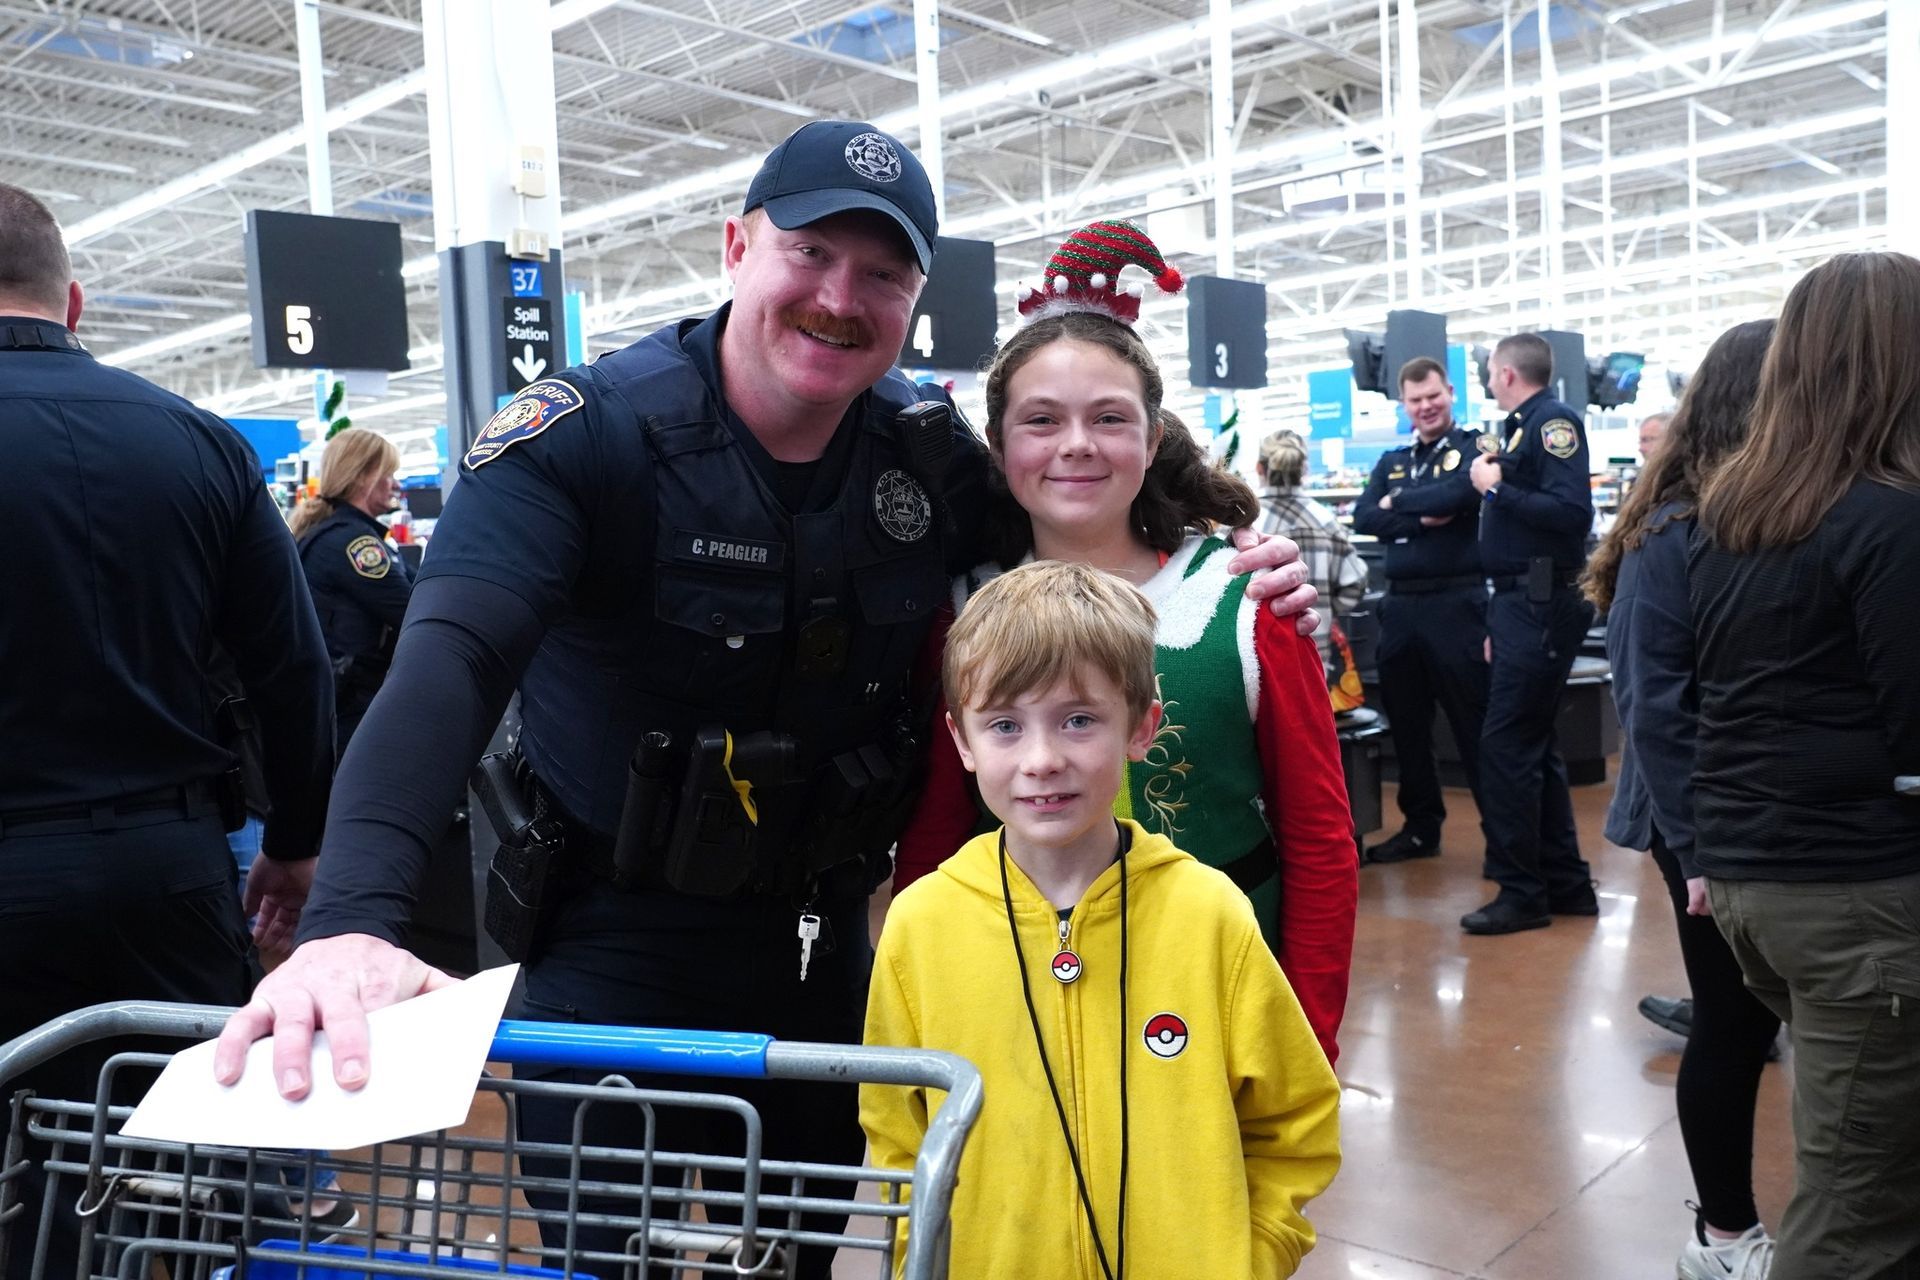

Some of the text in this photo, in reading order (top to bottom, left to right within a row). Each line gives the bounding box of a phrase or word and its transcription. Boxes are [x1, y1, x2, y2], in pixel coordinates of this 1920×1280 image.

[512, 268, 538, 291] 37
[513, 306, 540, 324] Spill
[286, 305, 314, 355] 5
[506, 324, 550, 341] Station
[912, 314, 934, 358] 4
[1215, 343, 1229, 379] 3
[692, 538, 768, 563] C. PEAGLER
